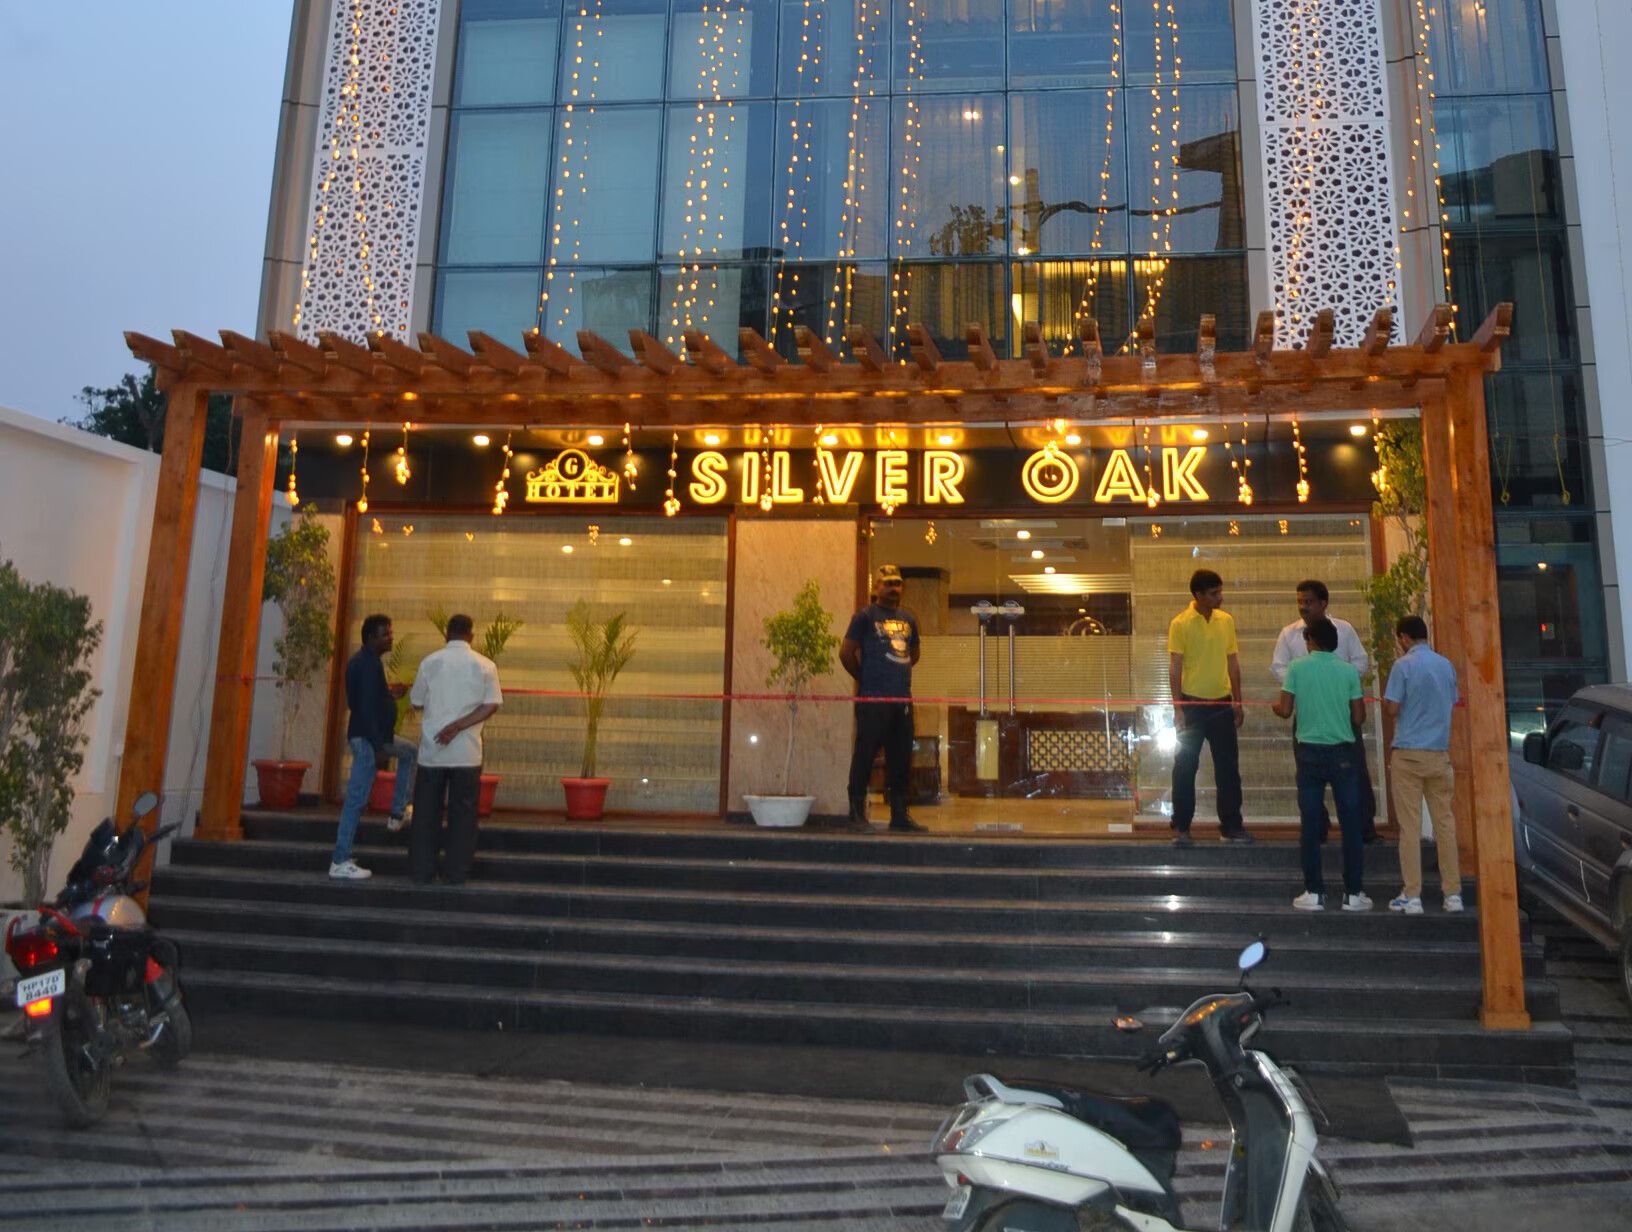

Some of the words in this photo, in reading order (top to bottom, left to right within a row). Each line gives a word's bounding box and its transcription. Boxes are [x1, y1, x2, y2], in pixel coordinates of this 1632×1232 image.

[564, 456, 579, 476] G
[689, 451, 966, 504] SILVER
[1021, 446, 1210, 504] OAK
[526, 482, 615, 499] HOTEL
